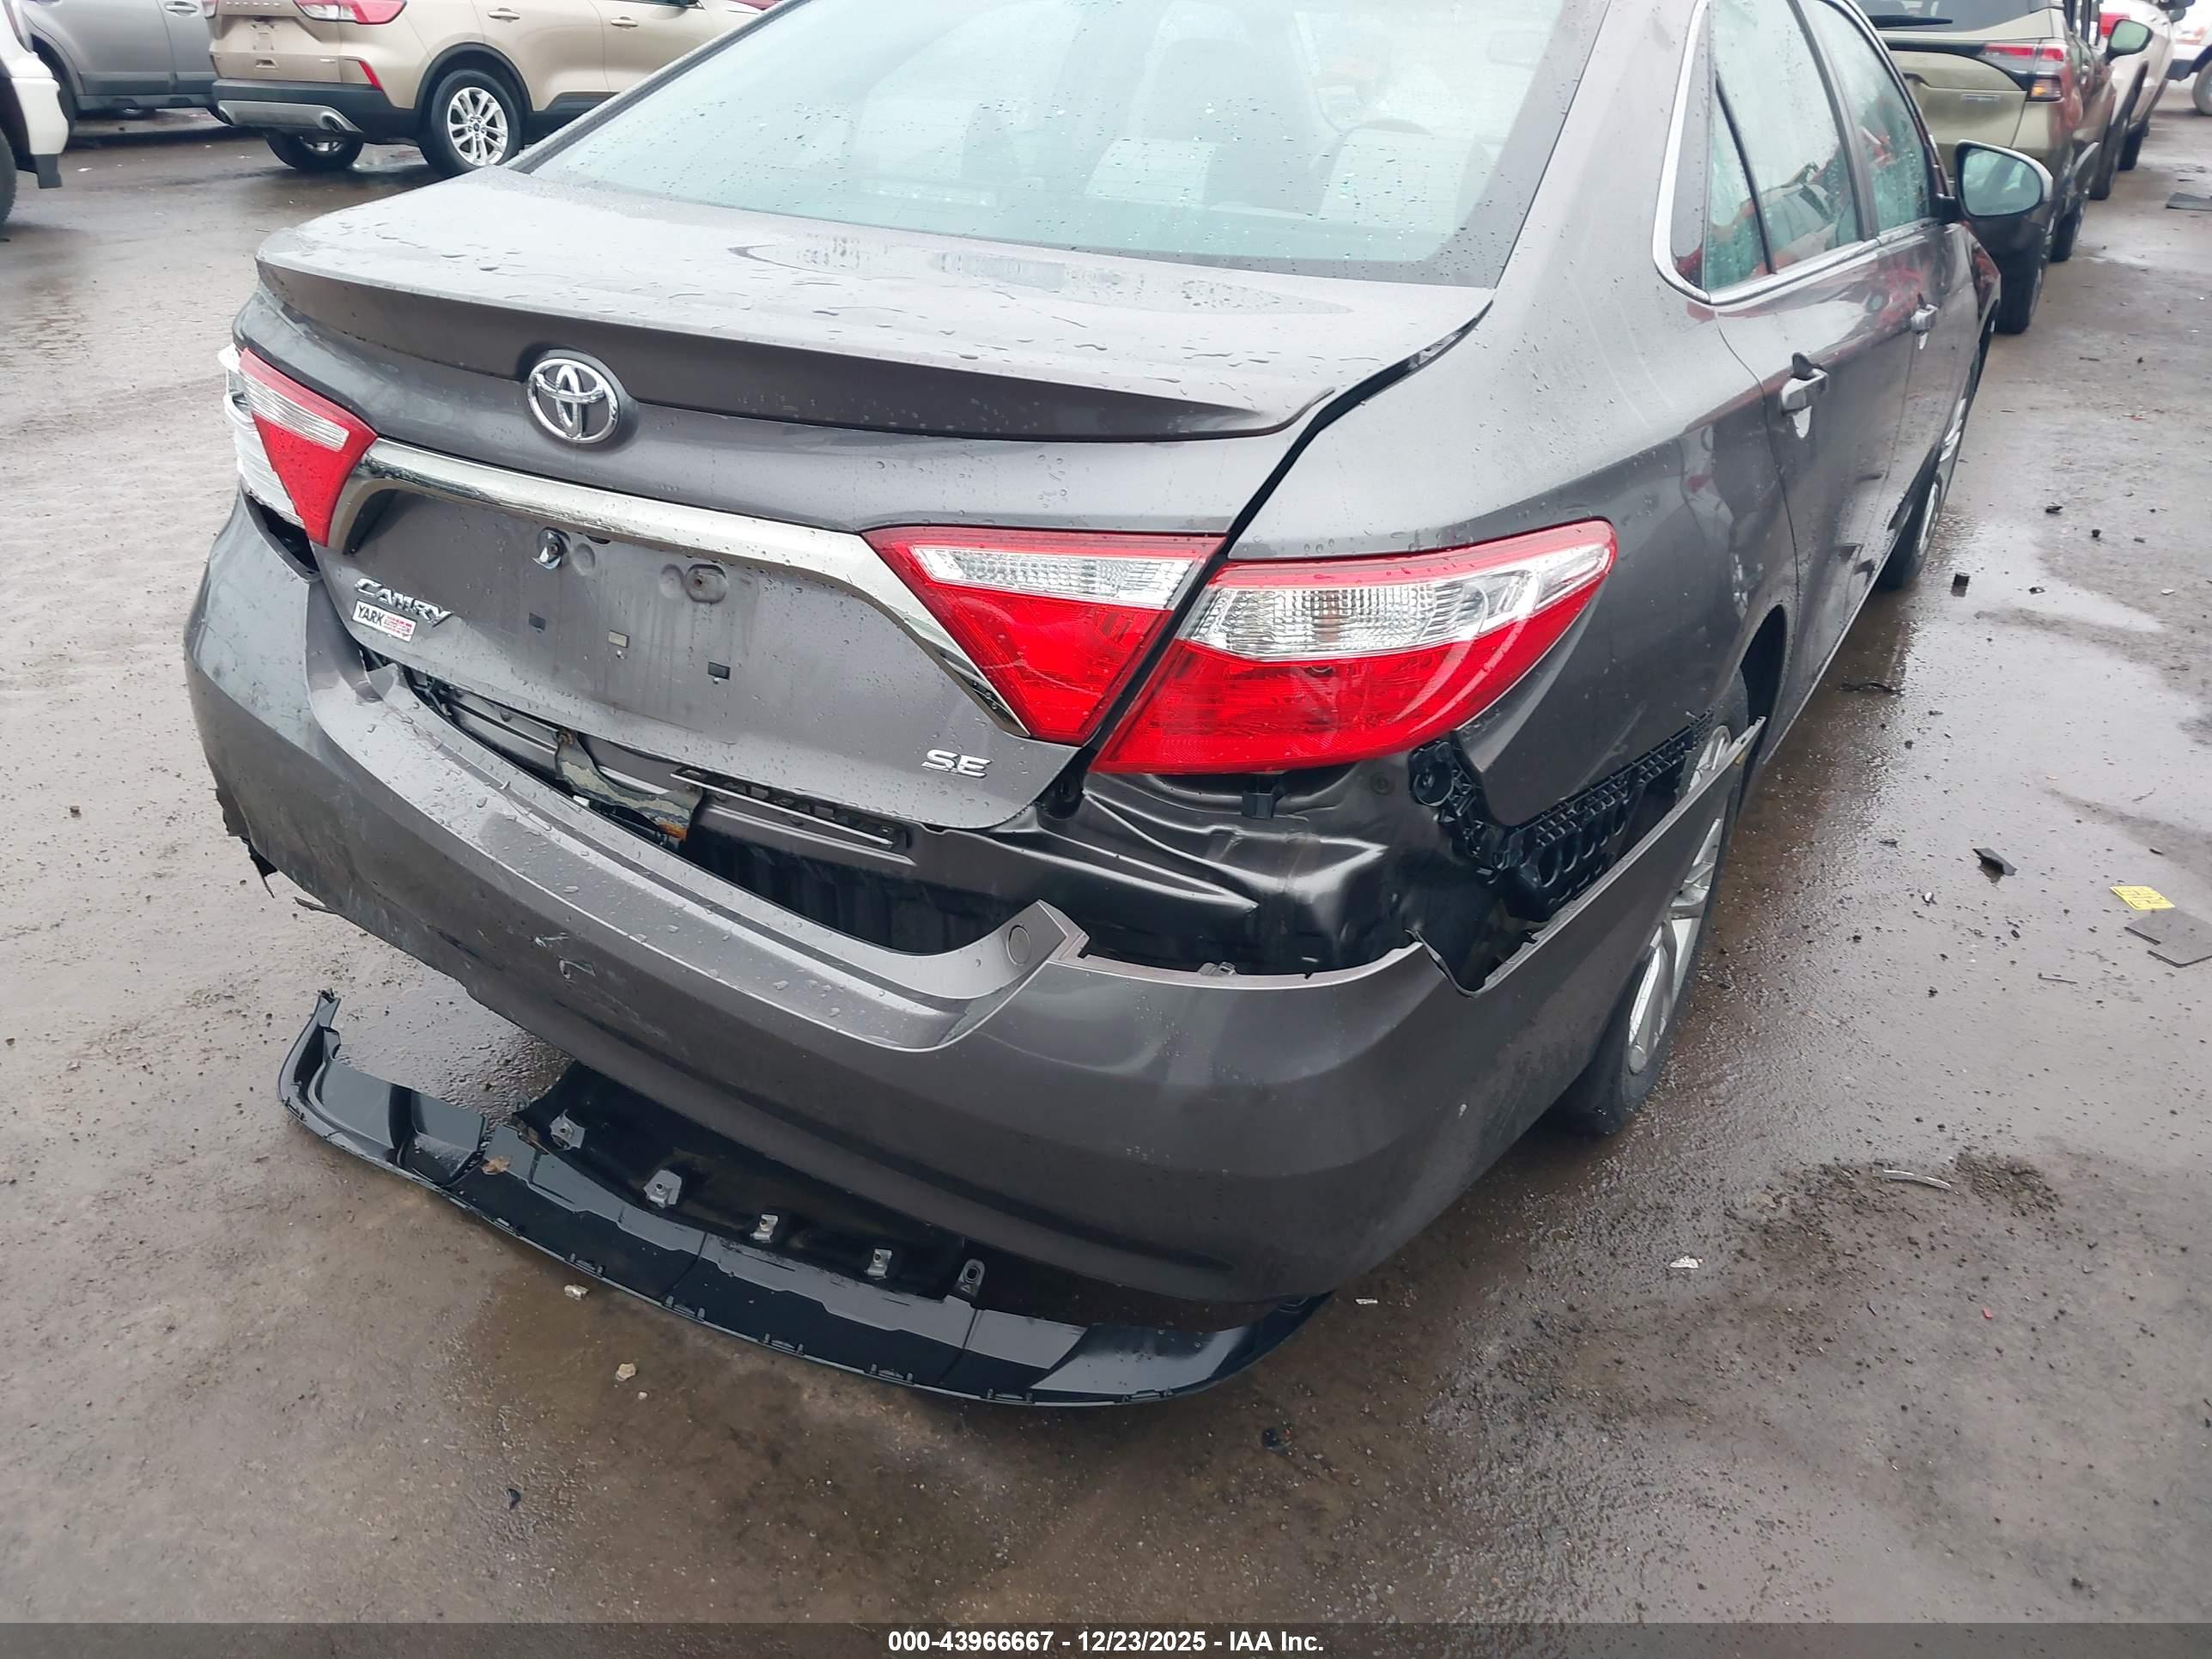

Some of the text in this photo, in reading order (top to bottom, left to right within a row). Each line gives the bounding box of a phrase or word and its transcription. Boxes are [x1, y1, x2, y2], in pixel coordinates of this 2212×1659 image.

[355, 578, 453, 628] CAMRY
[358, 605, 385, 626] YARK
[921, 749, 993, 779] SE
